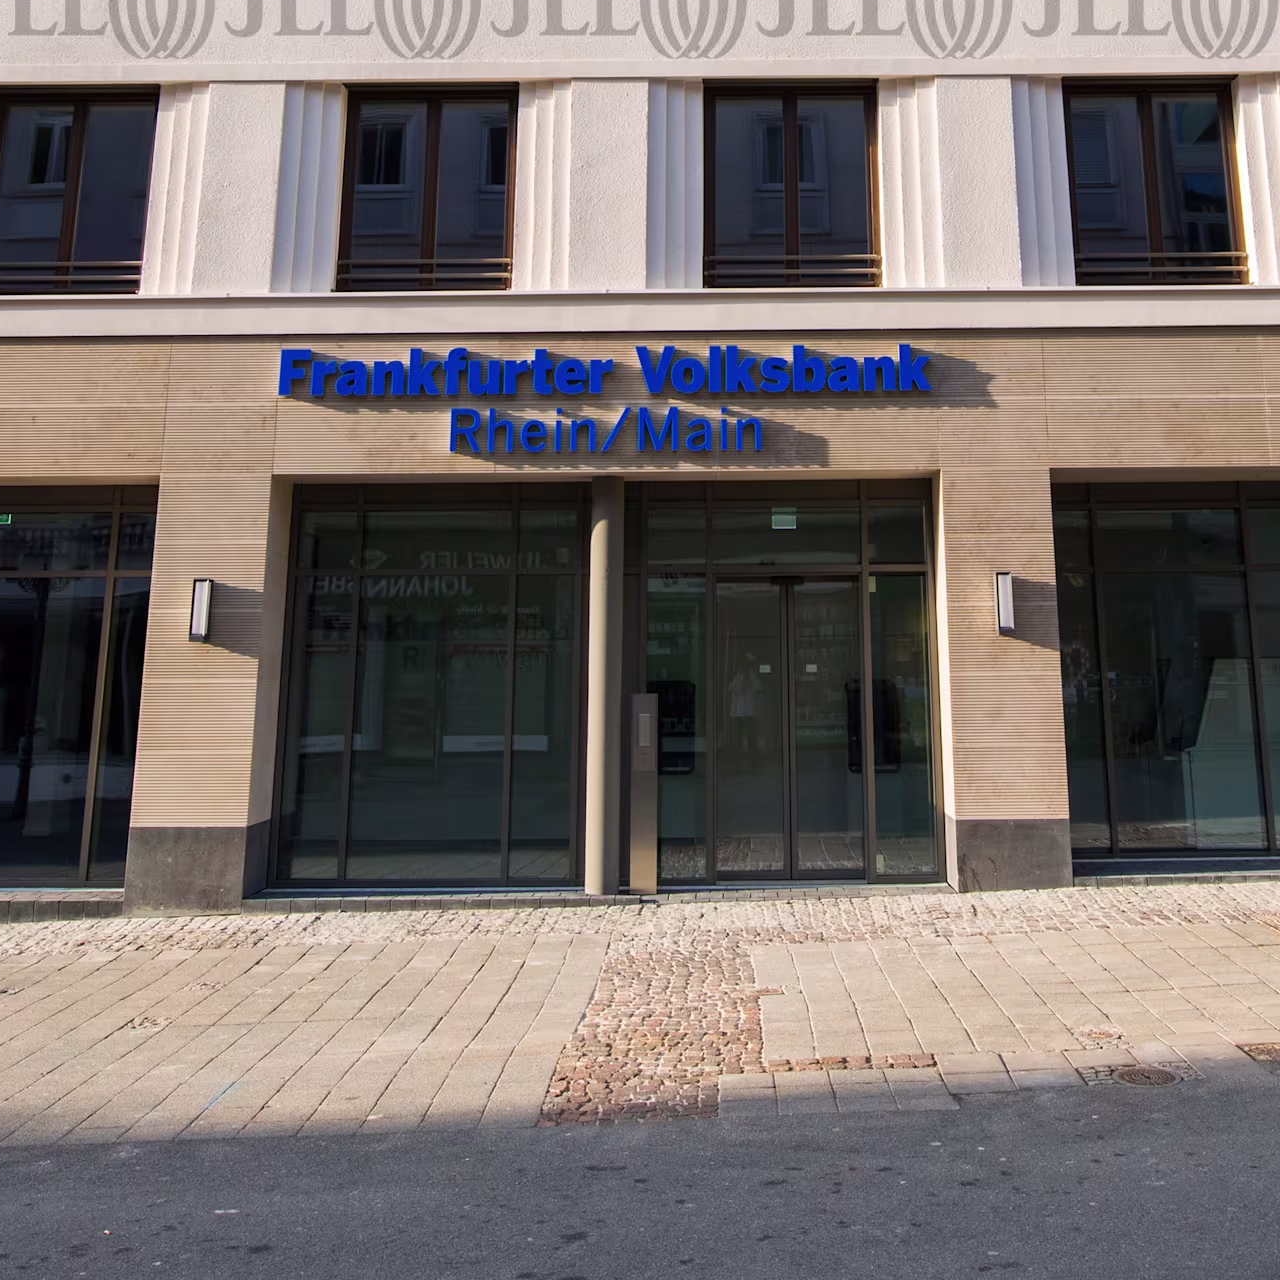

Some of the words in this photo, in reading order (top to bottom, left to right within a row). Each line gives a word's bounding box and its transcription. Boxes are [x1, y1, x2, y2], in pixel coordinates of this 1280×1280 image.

[277, 347, 614, 397] Frankfurter
[635, 344, 932, 395] Volksbank
[448, 407, 763, 454] Rhein/Main
